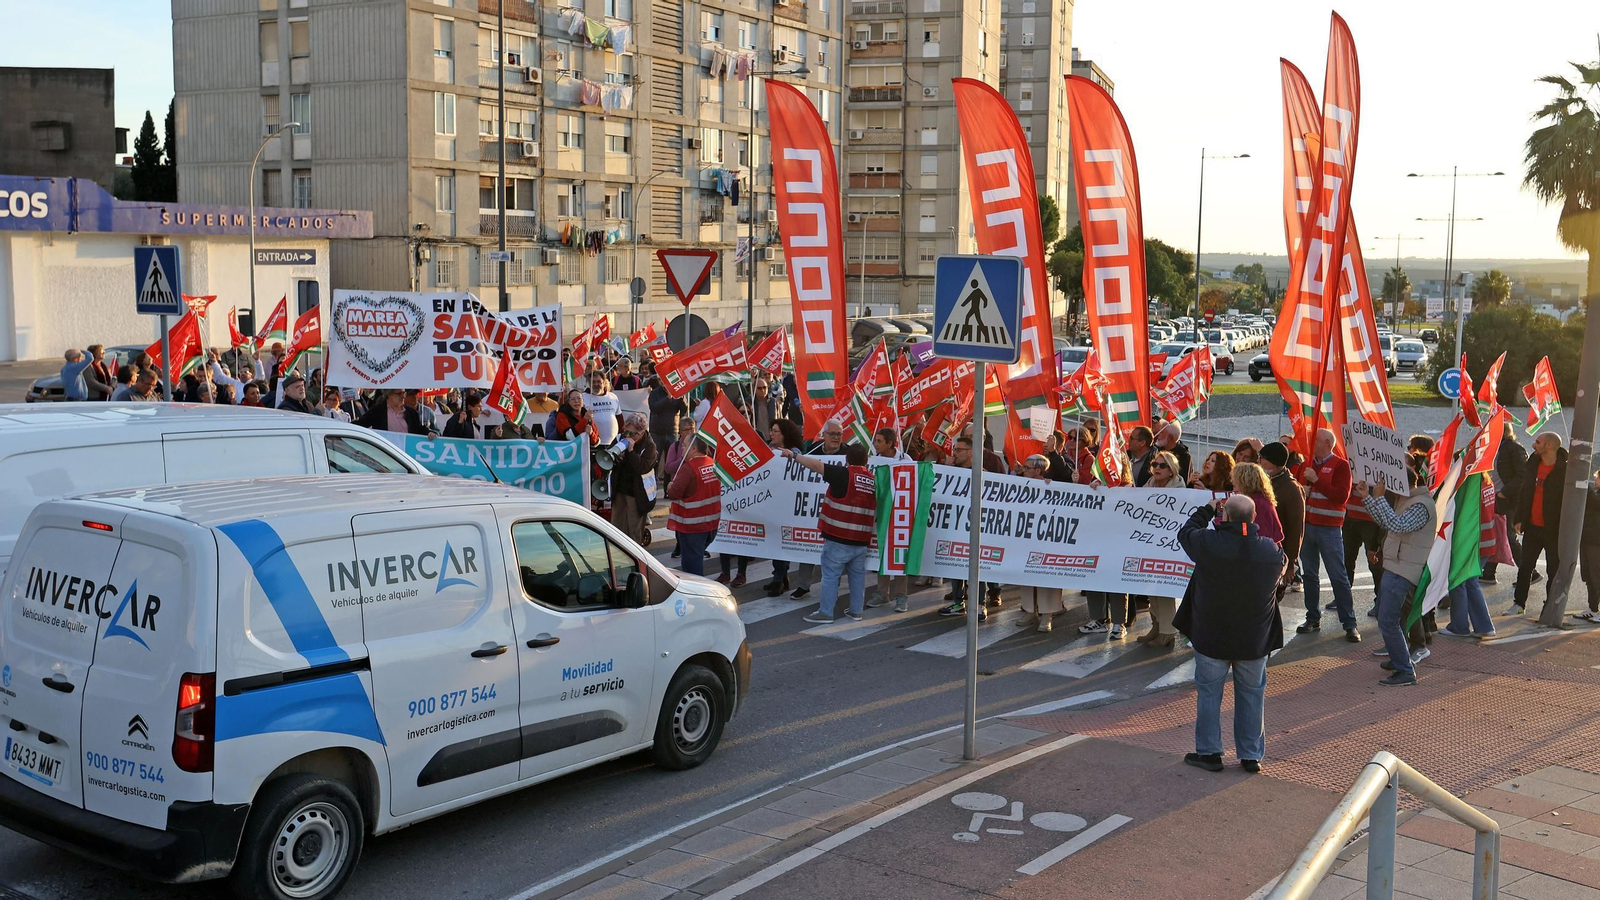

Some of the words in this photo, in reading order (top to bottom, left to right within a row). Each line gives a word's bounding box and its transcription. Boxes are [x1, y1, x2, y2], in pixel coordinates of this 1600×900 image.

[161, 212, 334, 230] SUPERMERCADOS
[257, 252, 299, 262] ENTRADA
[347, 310, 408, 324] MAREA
[432, 299, 456, 312] EN
[517, 313, 540, 327] DE
[347, 324, 407, 337] BLANCA
[432, 313, 557, 349] SANIDAD
[511, 347, 557, 361] 100
[352, 365, 371, 381] PUERTO
[379, 372, 395, 385] SANTA
[395, 359, 410, 375] MARÍA
[415, 440, 578, 469] SANIDAD
[726, 449, 747, 473] Cádiz
[1356, 441, 1369, 458] LA
[1371, 447, 1404, 470] SANIDAD
[942, 474, 955, 495] Y
[952, 476, 971, 498] LA
[975, 479, 1041, 504] TENCIÓN
[726, 489, 773, 515] PÚBLICA
[794, 492, 809, 517] DE
[729, 522, 757, 534] CCOO
[954, 504, 965, 531] Y
[1015, 511, 1035, 540] DE
[1036, 509, 1080, 545] CÁDIZ
[952, 544, 991, 558] CCO
[1129, 530, 1155, 544] DEL
[1156, 536, 1182, 552] SAS
[327, 541, 479, 594] INVERCAR
[1045, 556, 1086, 565] CCOO
[1142, 560, 1186, 574] CCOO
[25, 567, 161, 645] INVERCAR
[375, 592, 387, 602] de
[388, 588, 419, 601] alquiler
[51, 615, 60, 627] de
[61, 616, 88, 634] alquiler
[562, 658, 613, 682] Movilidad
[408, 696, 436, 719] 900
[440, 689, 468, 710] 877
[471, 683, 497, 703] 544
[560, 690, 568, 701] a
[569, 687, 581, 700] tu
[582, 677, 625, 697] servicio
[407, 708, 496, 740] invercarlogistica.com
[11, 742, 37, 769] 8433
[37, 754, 62, 779] MMT
[87, 750, 109, 771] 900
[112, 757, 136, 777] 877
[139, 764, 165, 784] 544
[88, 775, 166, 803] invercarlogistica.com
